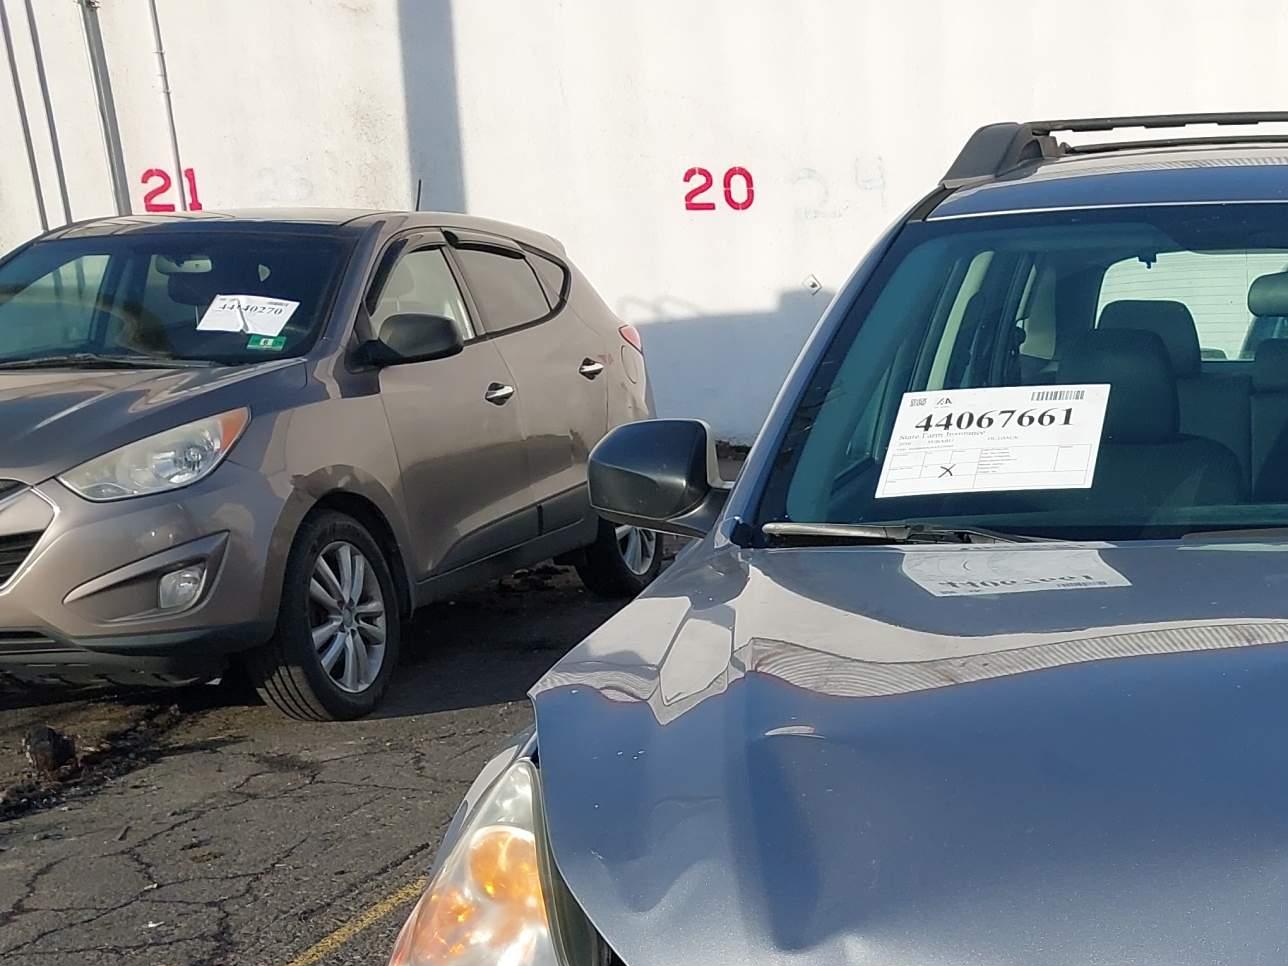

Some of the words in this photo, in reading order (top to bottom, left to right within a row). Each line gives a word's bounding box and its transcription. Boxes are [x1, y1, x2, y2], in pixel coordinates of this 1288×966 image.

[141, 167, 203, 212] 21
[683, 166, 755, 211] 20
[914, 407, 1073, 432] 44067661
